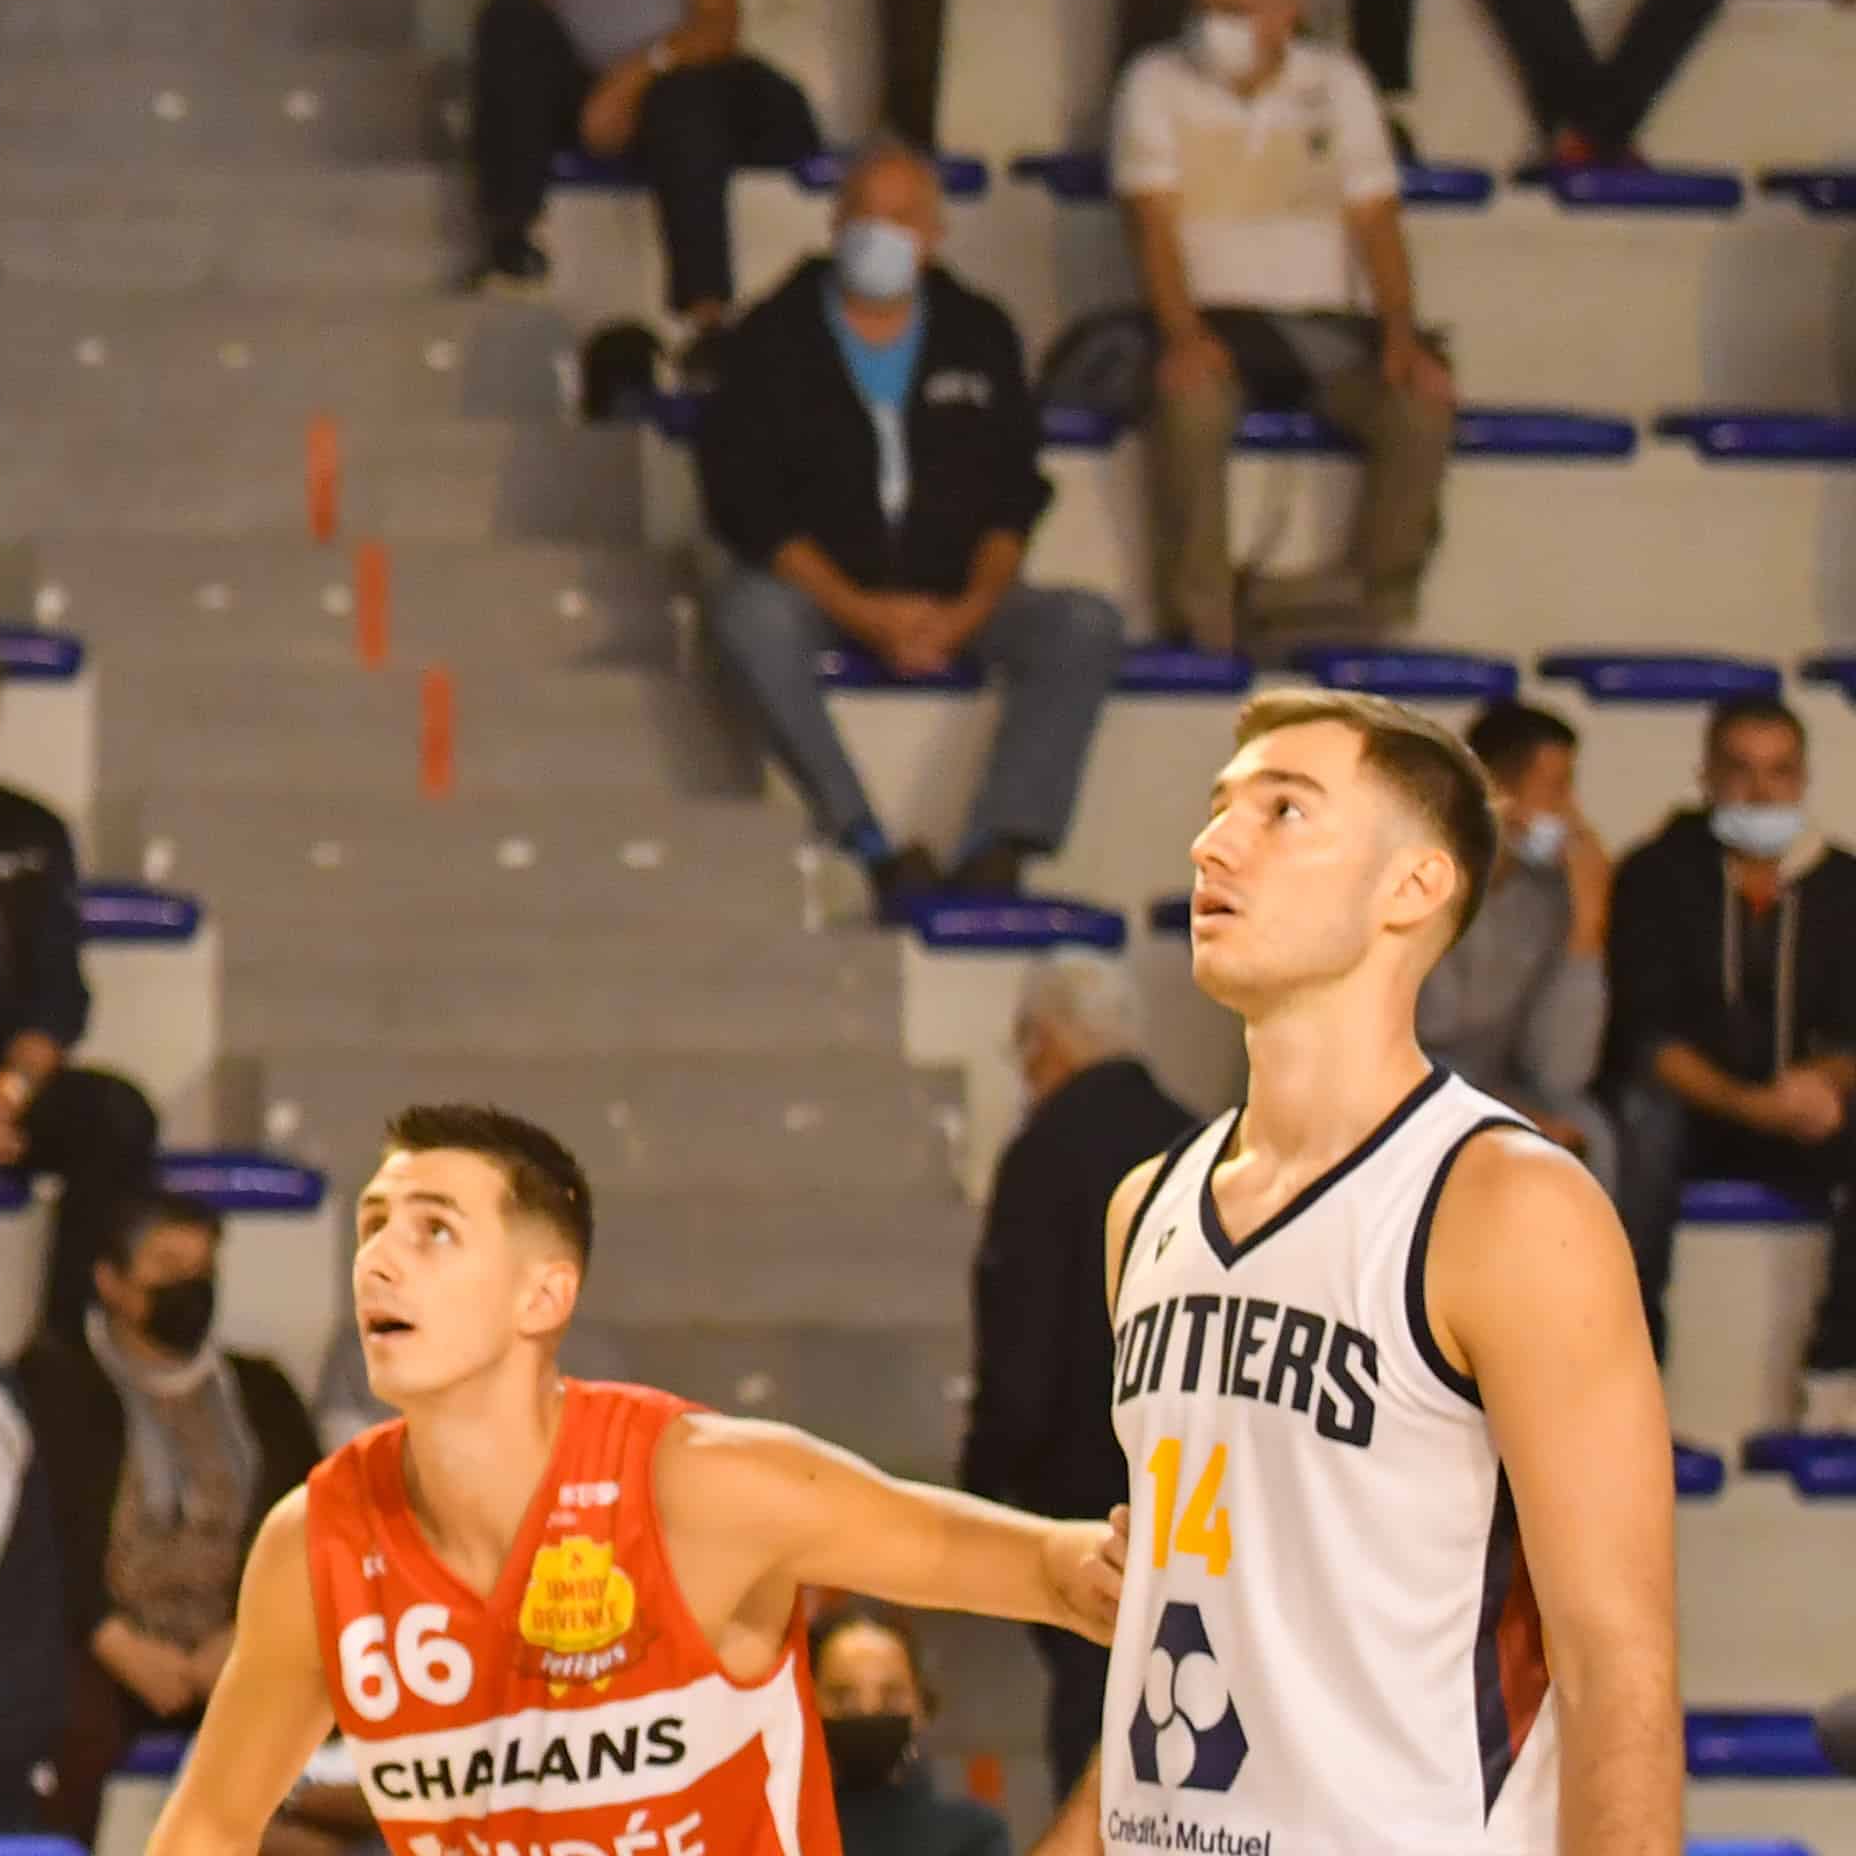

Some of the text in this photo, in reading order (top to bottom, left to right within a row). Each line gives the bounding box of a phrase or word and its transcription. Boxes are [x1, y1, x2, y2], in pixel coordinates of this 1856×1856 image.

[1115, 1293, 1379, 1449] OITIERS
[1147, 1437, 1232, 1576] 14
[338, 1604, 474, 1722] 66
[1175, 1820, 1271, 1856] Mutuel
